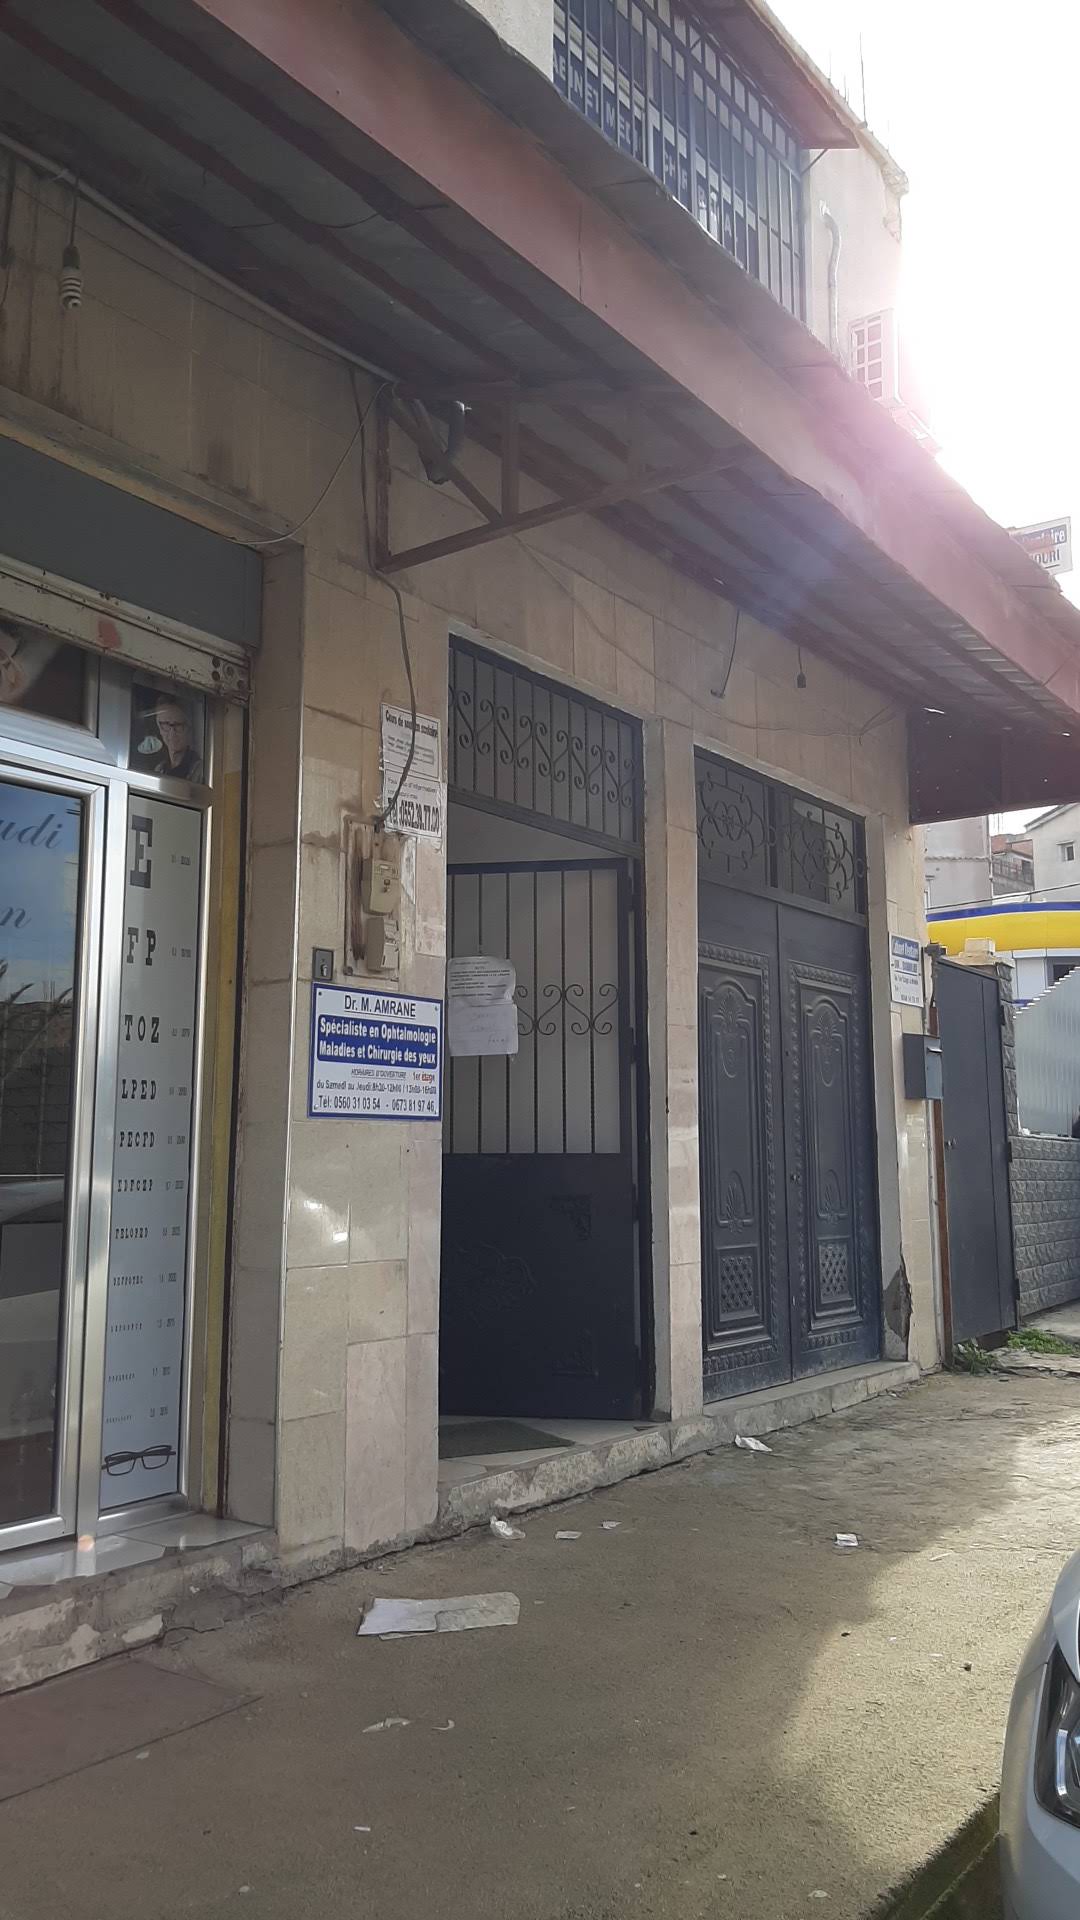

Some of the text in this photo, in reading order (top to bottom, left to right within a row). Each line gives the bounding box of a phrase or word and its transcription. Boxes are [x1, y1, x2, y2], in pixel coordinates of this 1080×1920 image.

[130, 815, 153, 889] E
[344, 995, 416, 1017] Dr. M. AMRANE
[320, 1017, 436, 1046] Spécialiste en Ophtalmologie
[320, 1040, 436, 1066] Maladies et Chirurgie des yeux
[317, 1080, 324, 1089] du
[325, 1080, 347, 1090] Samedi
[348, 1082, 355, 1091] au
[334, 1096, 351, 1109] 0560
[352, 1097, 360, 1110] 31
[362, 1097, 371, 1110] 03
[372, 1097, 380, 1110] 54
[392, 1098, 408, 1111] 0673
[409, 1099, 416, 1111] 81
[418, 1099, 425, 1111] 97
[427, 1100, 435, 1112] 46
